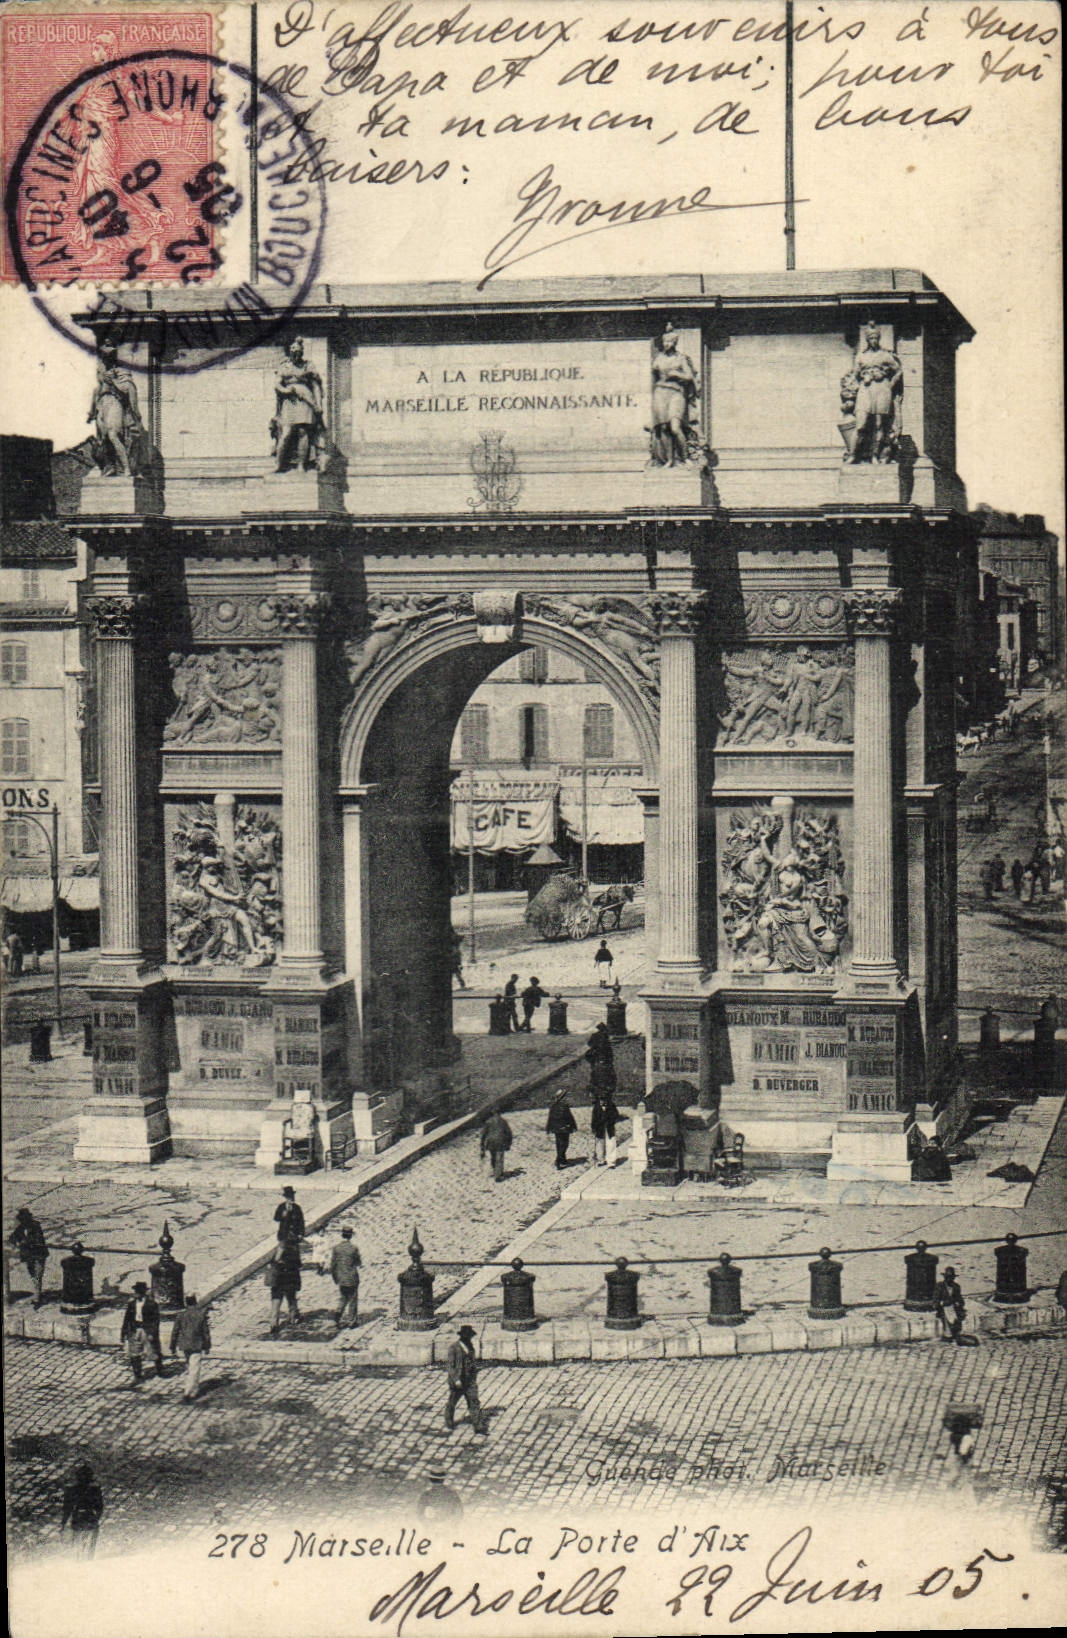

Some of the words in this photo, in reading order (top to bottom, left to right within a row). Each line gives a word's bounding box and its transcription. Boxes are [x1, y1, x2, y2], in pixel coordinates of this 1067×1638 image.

[122, 24, 206, 42] FRANÇAISE
[275, 0, 577, 60] D'affectueux
[606, 7, 866, 44] souvenirs
[964, 7, 1058, 46] tous
[320, 38, 448, 107] Papa
[559, 56, 615, 85] de
[798, 49, 956, 99] pour
[977, 46, 1051, 83] toi
[357, 103, 410, 138] ta
[692, 100, 759, 135] de
[416, 371, 430, 384] A
[442, 370, 467, 384] LA
[365, 399, 469, 414] MARSEILLE
[2, 788, 50, 809] ONS
[369, 1561, 628, 1638] Marseille
[729, 1525, 884, 1623] Juin
